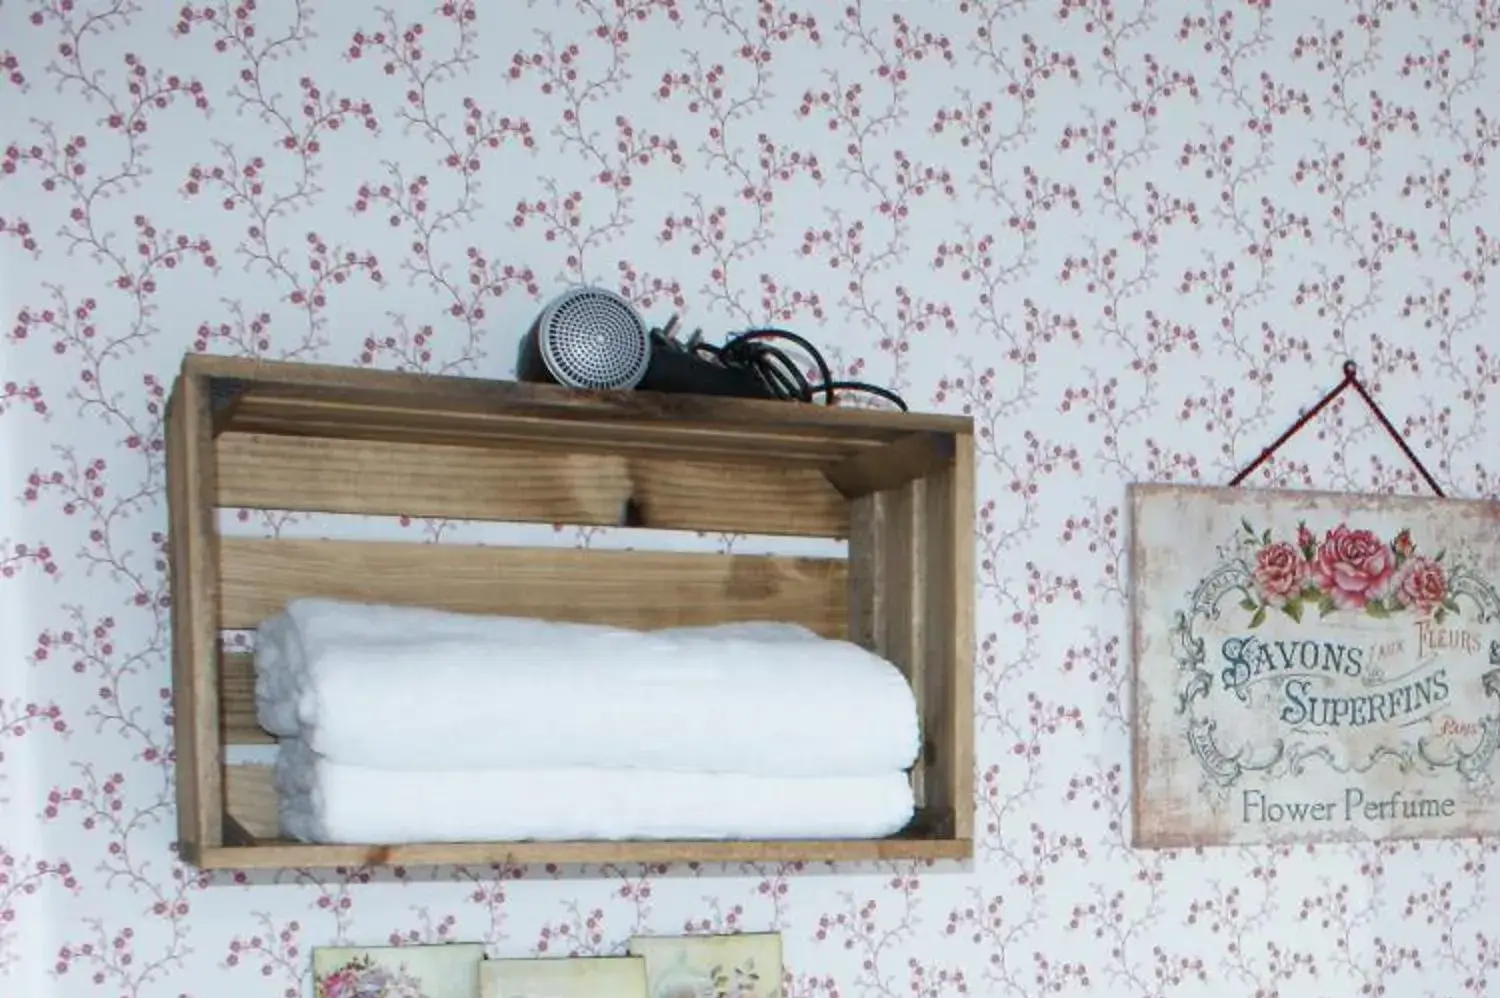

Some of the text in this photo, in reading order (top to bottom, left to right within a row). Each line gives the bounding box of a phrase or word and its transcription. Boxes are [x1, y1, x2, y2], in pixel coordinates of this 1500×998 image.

[1222, 636, 1363, 700] SAVONS
[1415, 621, 1480, 657] FLEURS
[1280, 669, 1449, 727] SUPERFINS
[1243, 787, 1455, 822] Flower Perfume
